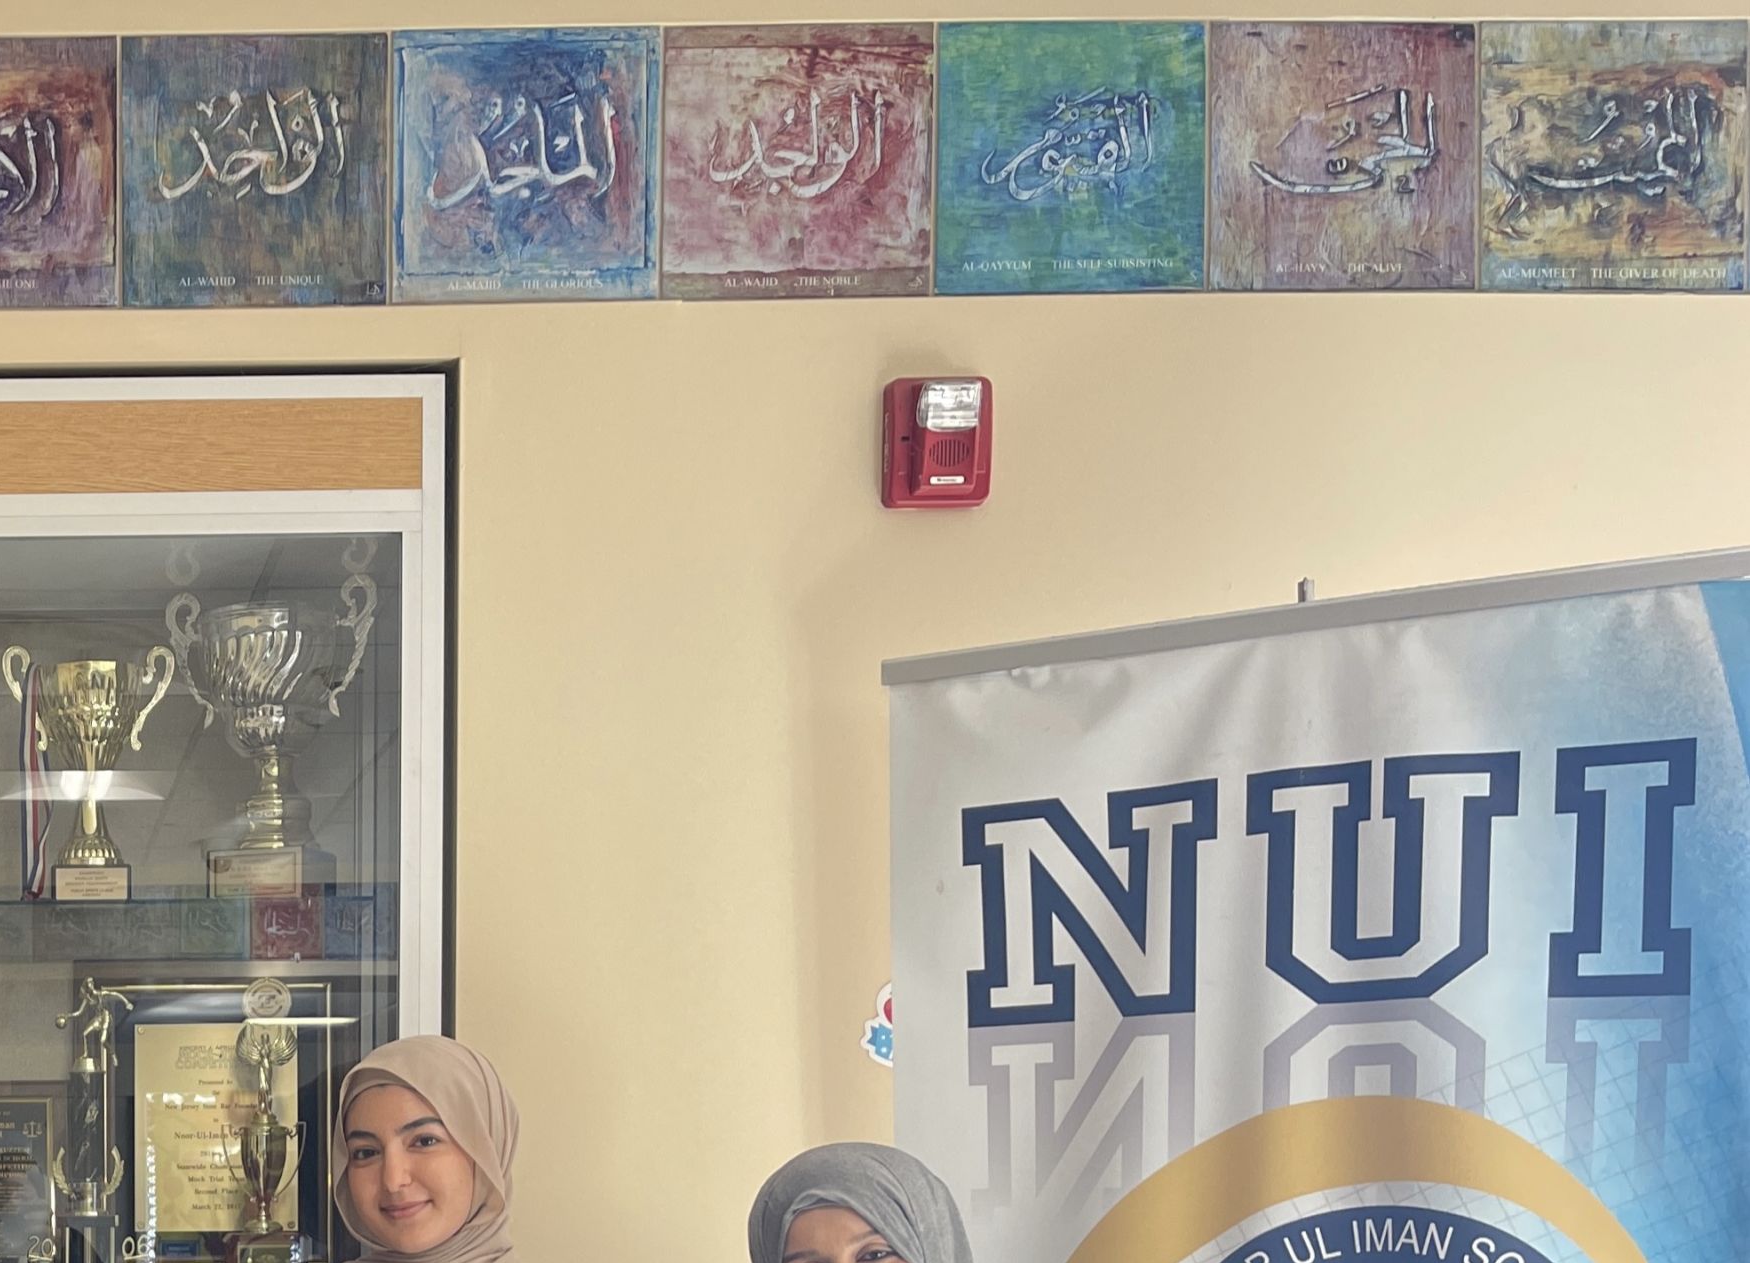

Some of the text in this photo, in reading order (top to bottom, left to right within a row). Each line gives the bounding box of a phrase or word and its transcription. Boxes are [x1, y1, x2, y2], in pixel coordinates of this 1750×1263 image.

[962, 260, 1031, 272] AL-QAYYUM
[1052, 260, 1072, 270] THE
[1348, 263, 1366, 272] THE
[1371, 263, 1402, 272] ALIVE
[1500, 268, 1726, 279] AL-MUMEET THE GIVER OF DEATH
[15, 279, 38, 288] ONE
[179, 275, 322, 287] AL-WAHID THE UNIQUE
[449, 278, 603, 290] AL-MAJID THE GLORIOUS
[725, 276, 860, 288] AL-WAJID THE NOBLE
[961, 737, 1698, 1029] NUI
[1350, 1217, 1454, 1260] IMAN
